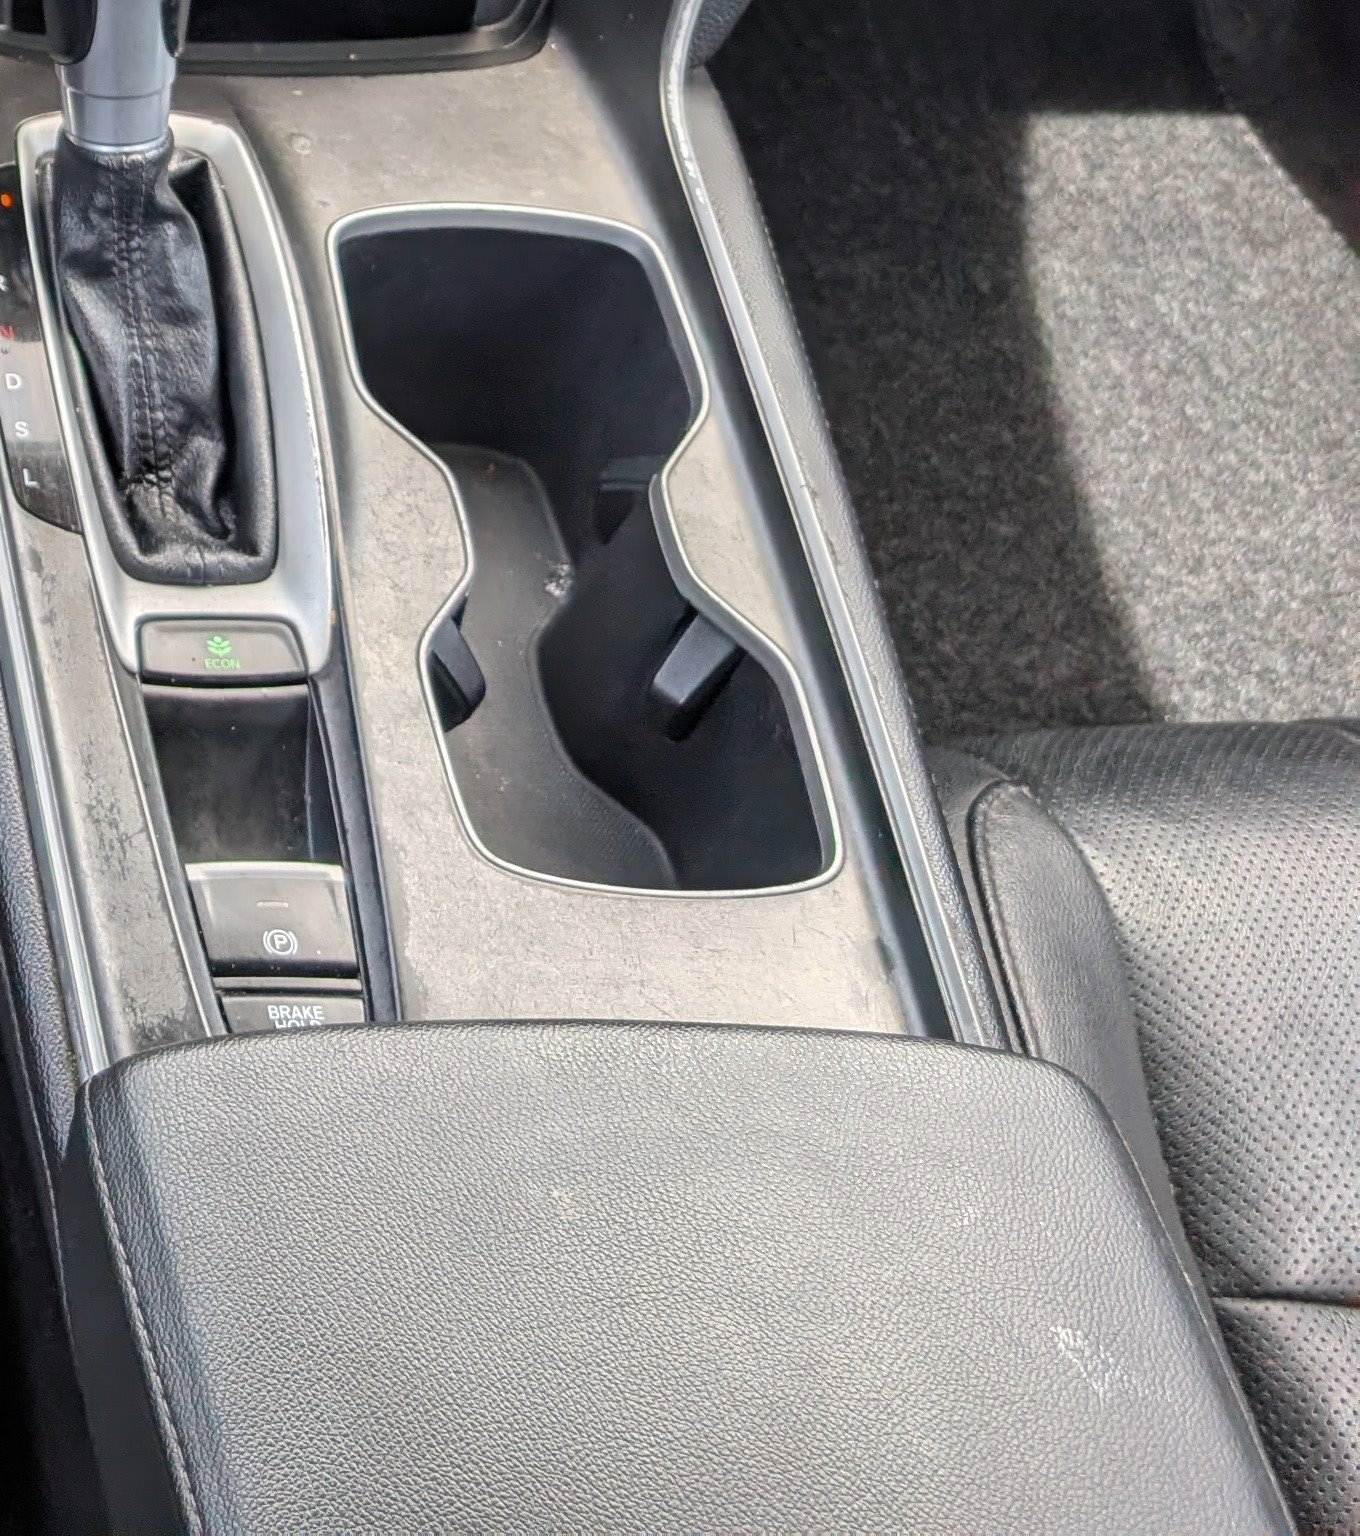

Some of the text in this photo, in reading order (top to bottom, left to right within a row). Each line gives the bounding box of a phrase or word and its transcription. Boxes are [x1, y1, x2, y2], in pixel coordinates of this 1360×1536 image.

[5, 372, 21, 390] D
[15, 421, 29, 440] S
[23, 468, 40, 488] L
[204, 658, 240, 670] ECON
[267, 1005, 325, 1020] BRAKE
